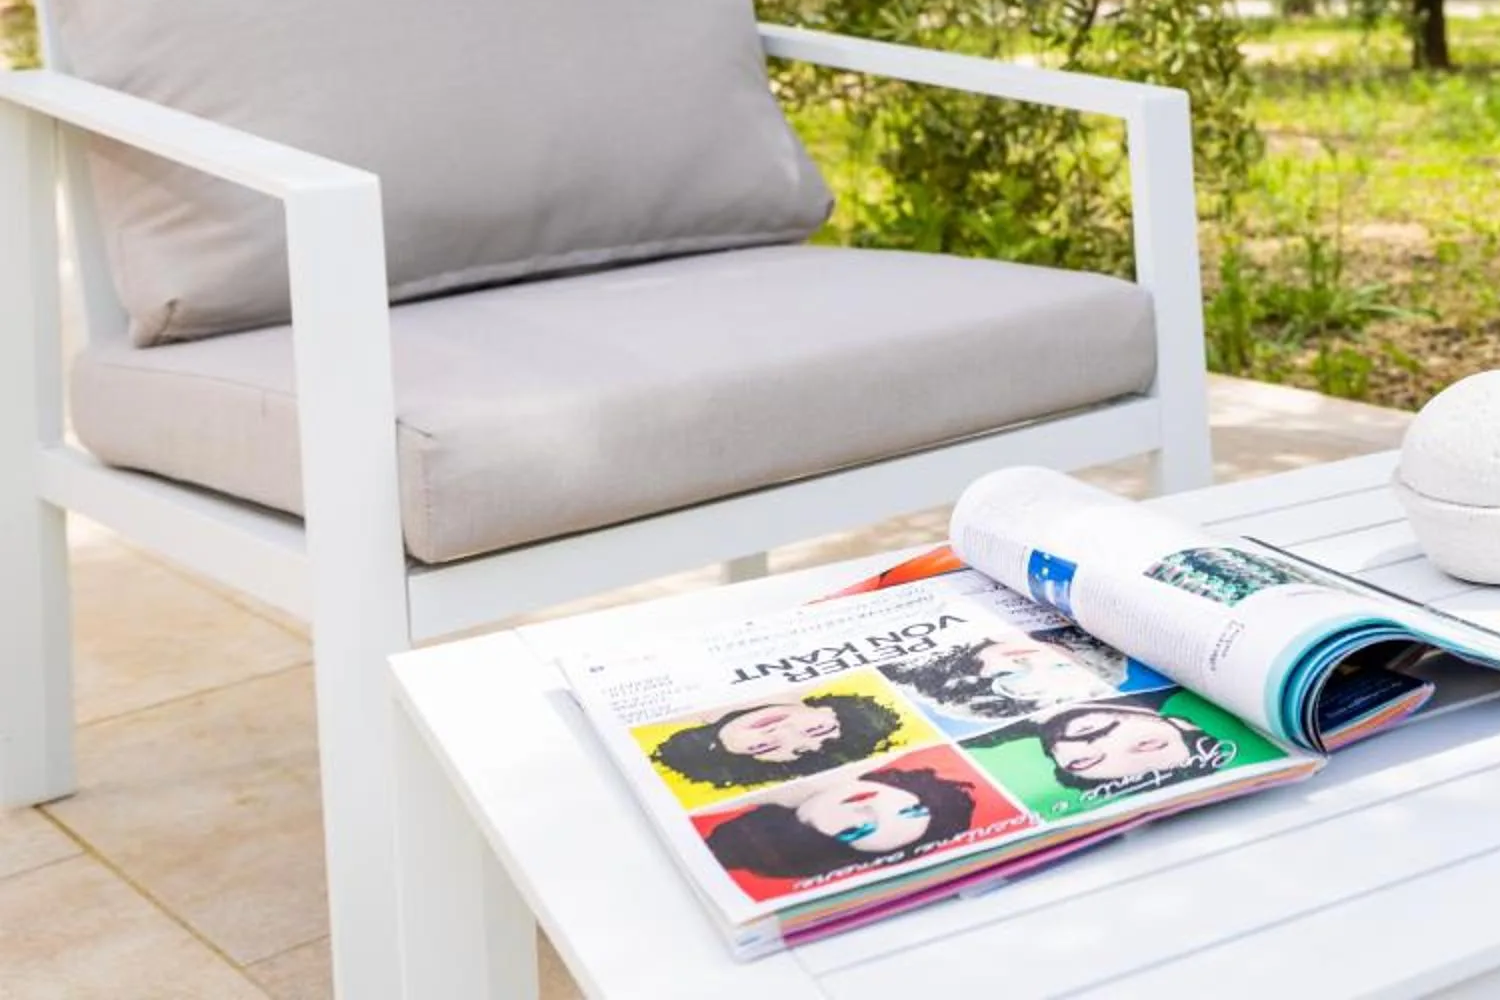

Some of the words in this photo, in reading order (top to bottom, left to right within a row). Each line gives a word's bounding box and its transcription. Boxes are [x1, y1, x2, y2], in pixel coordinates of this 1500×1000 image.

[866, 614, 968, 647] VON
[730, 641, 860, 685] KANT
[782, 637, 937, 683] PETER
